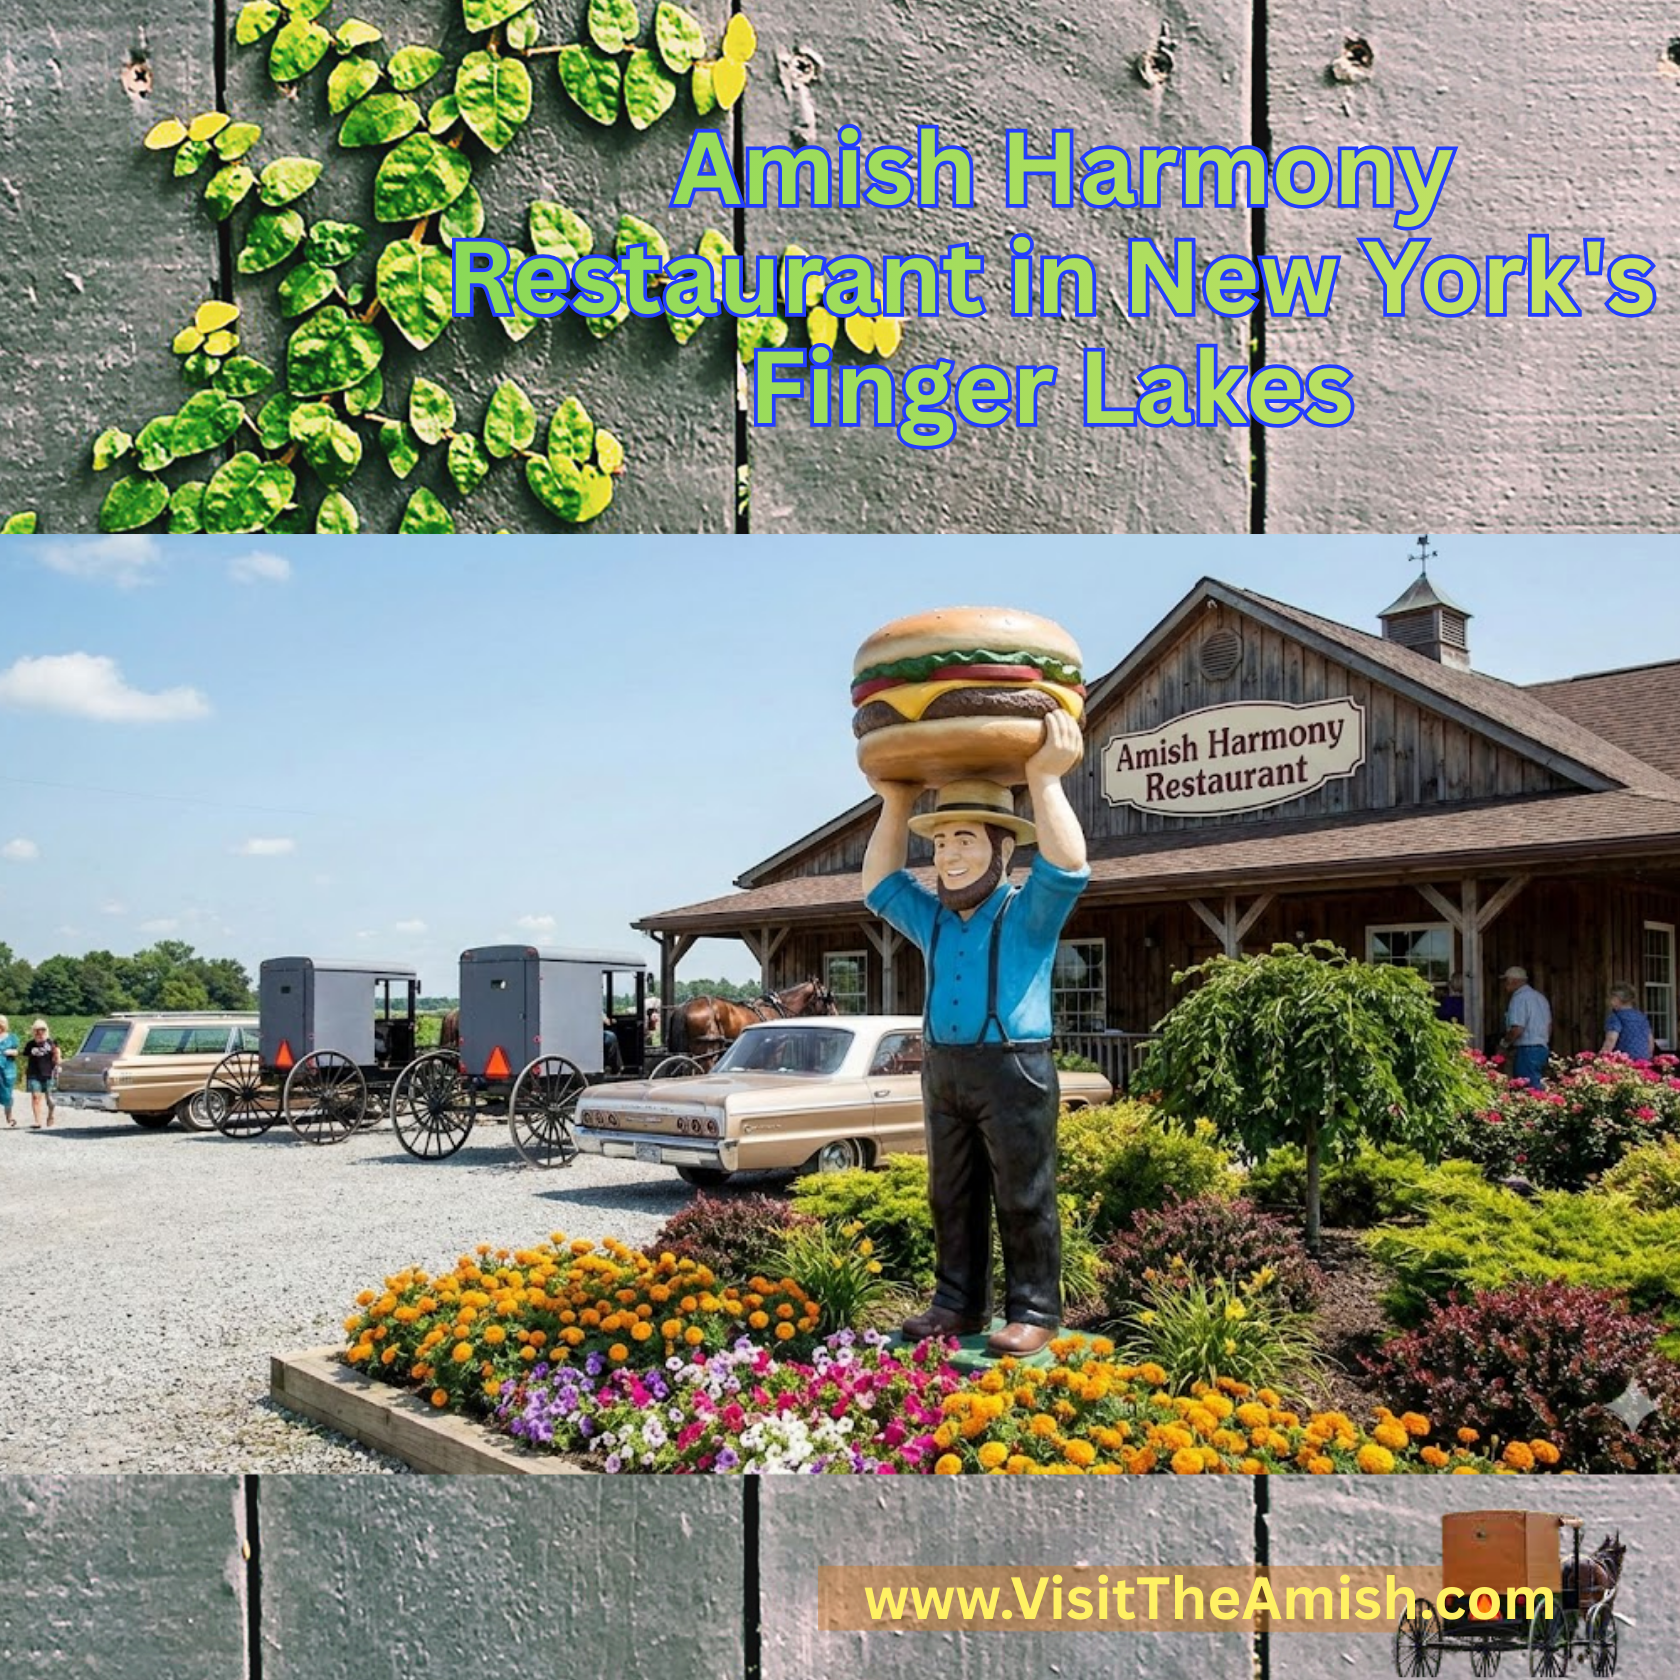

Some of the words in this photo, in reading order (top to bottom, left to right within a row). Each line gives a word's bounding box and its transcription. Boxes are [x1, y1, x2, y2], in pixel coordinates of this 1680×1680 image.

[1116, 733, 1198, 771] Amish
[1208, 718, 1344, 758] Harmony
[1145, 755, 1308, 802] Restaurant
